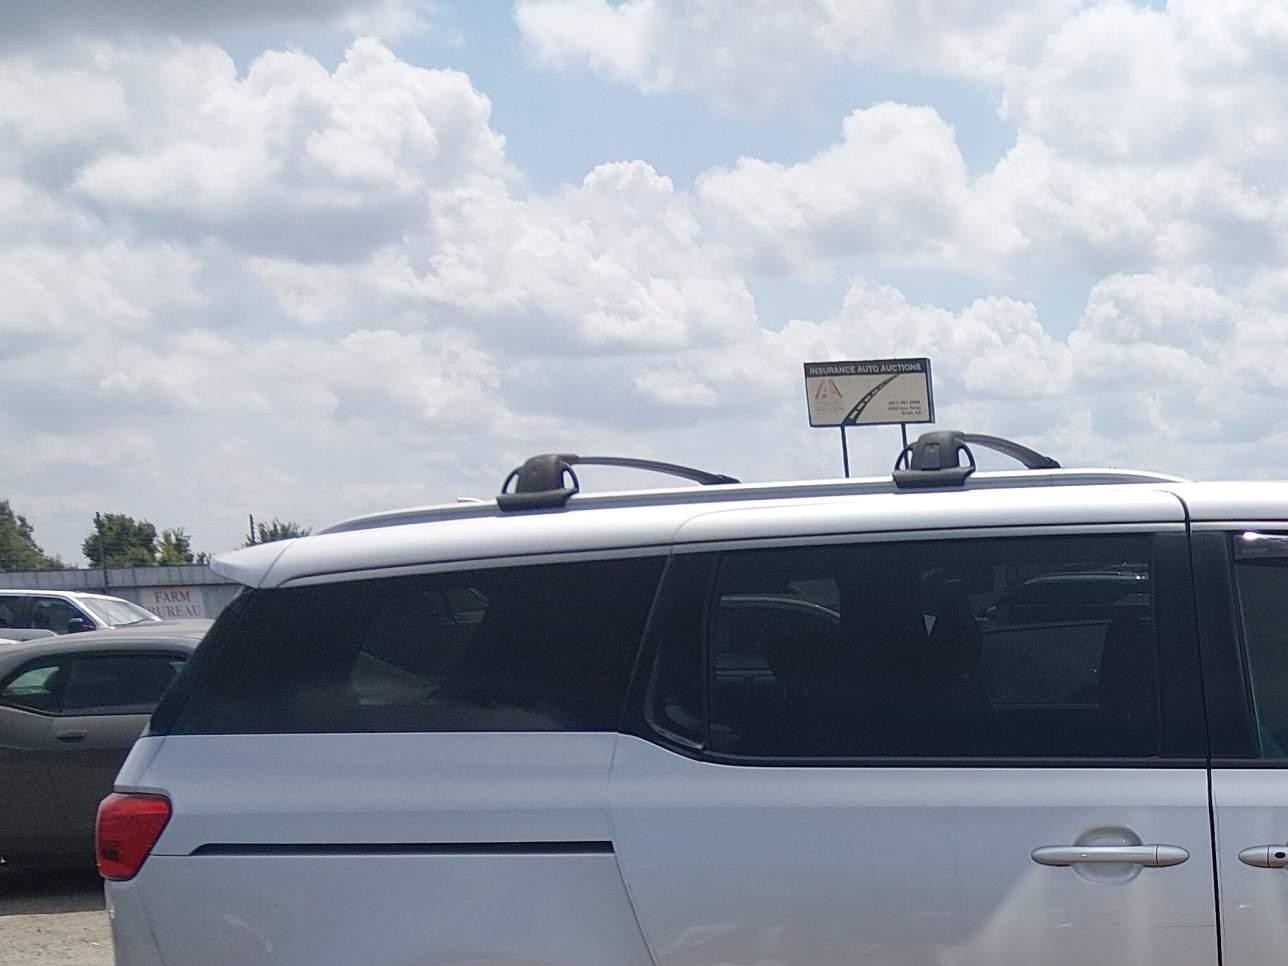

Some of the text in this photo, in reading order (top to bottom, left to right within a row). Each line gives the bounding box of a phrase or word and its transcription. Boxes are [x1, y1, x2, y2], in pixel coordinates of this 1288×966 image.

[810, 362, 922, 376] INSURANCE AUTO AUCTIONS
[154, 591, 191, 603] FARM
